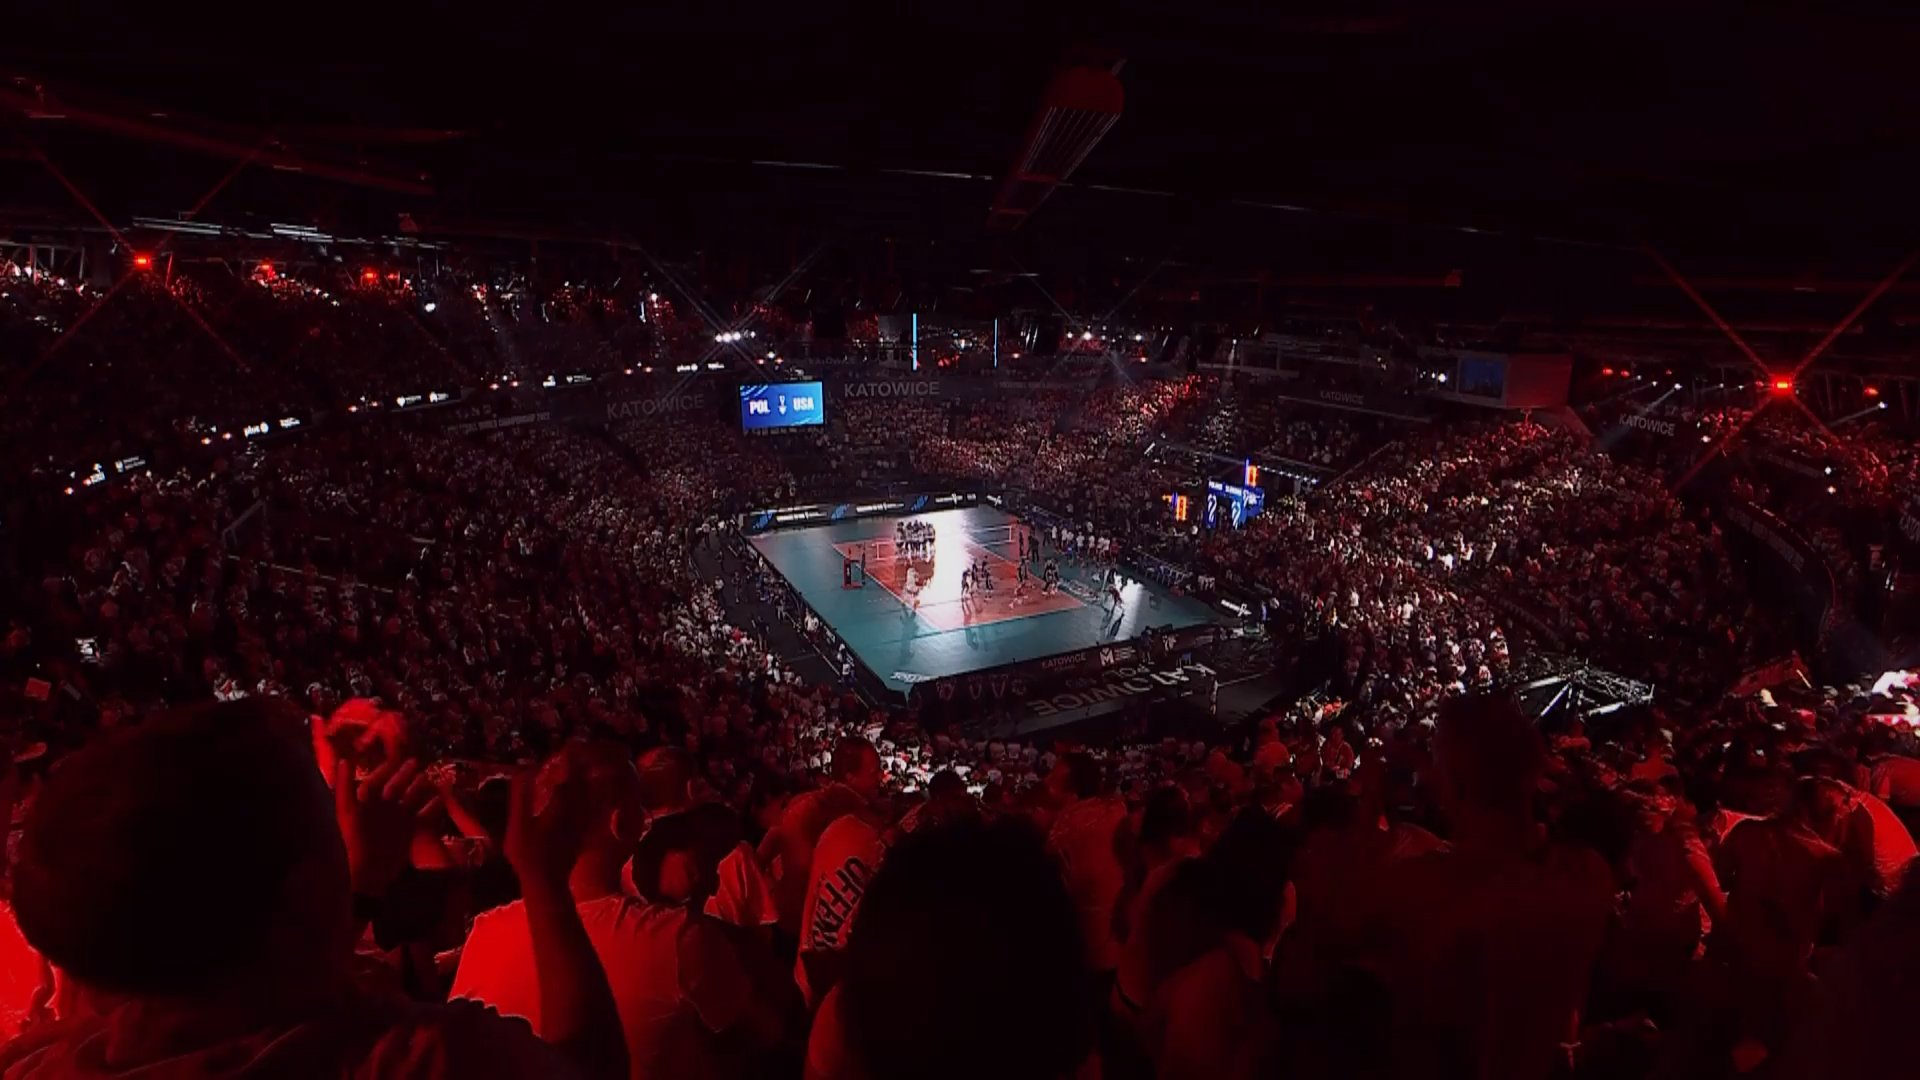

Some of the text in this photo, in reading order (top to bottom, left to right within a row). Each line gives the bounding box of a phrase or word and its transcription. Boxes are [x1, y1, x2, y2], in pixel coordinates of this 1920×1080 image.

[844, 381, 941, 399] KATOWICE
[607, 393, 705, 420] KATOWICE
[749, 397, 815, 415] POL USA
[1619, 413, 1676, 437] KATOWICE
[1041, 653, 1087, 668] KATOWICE
